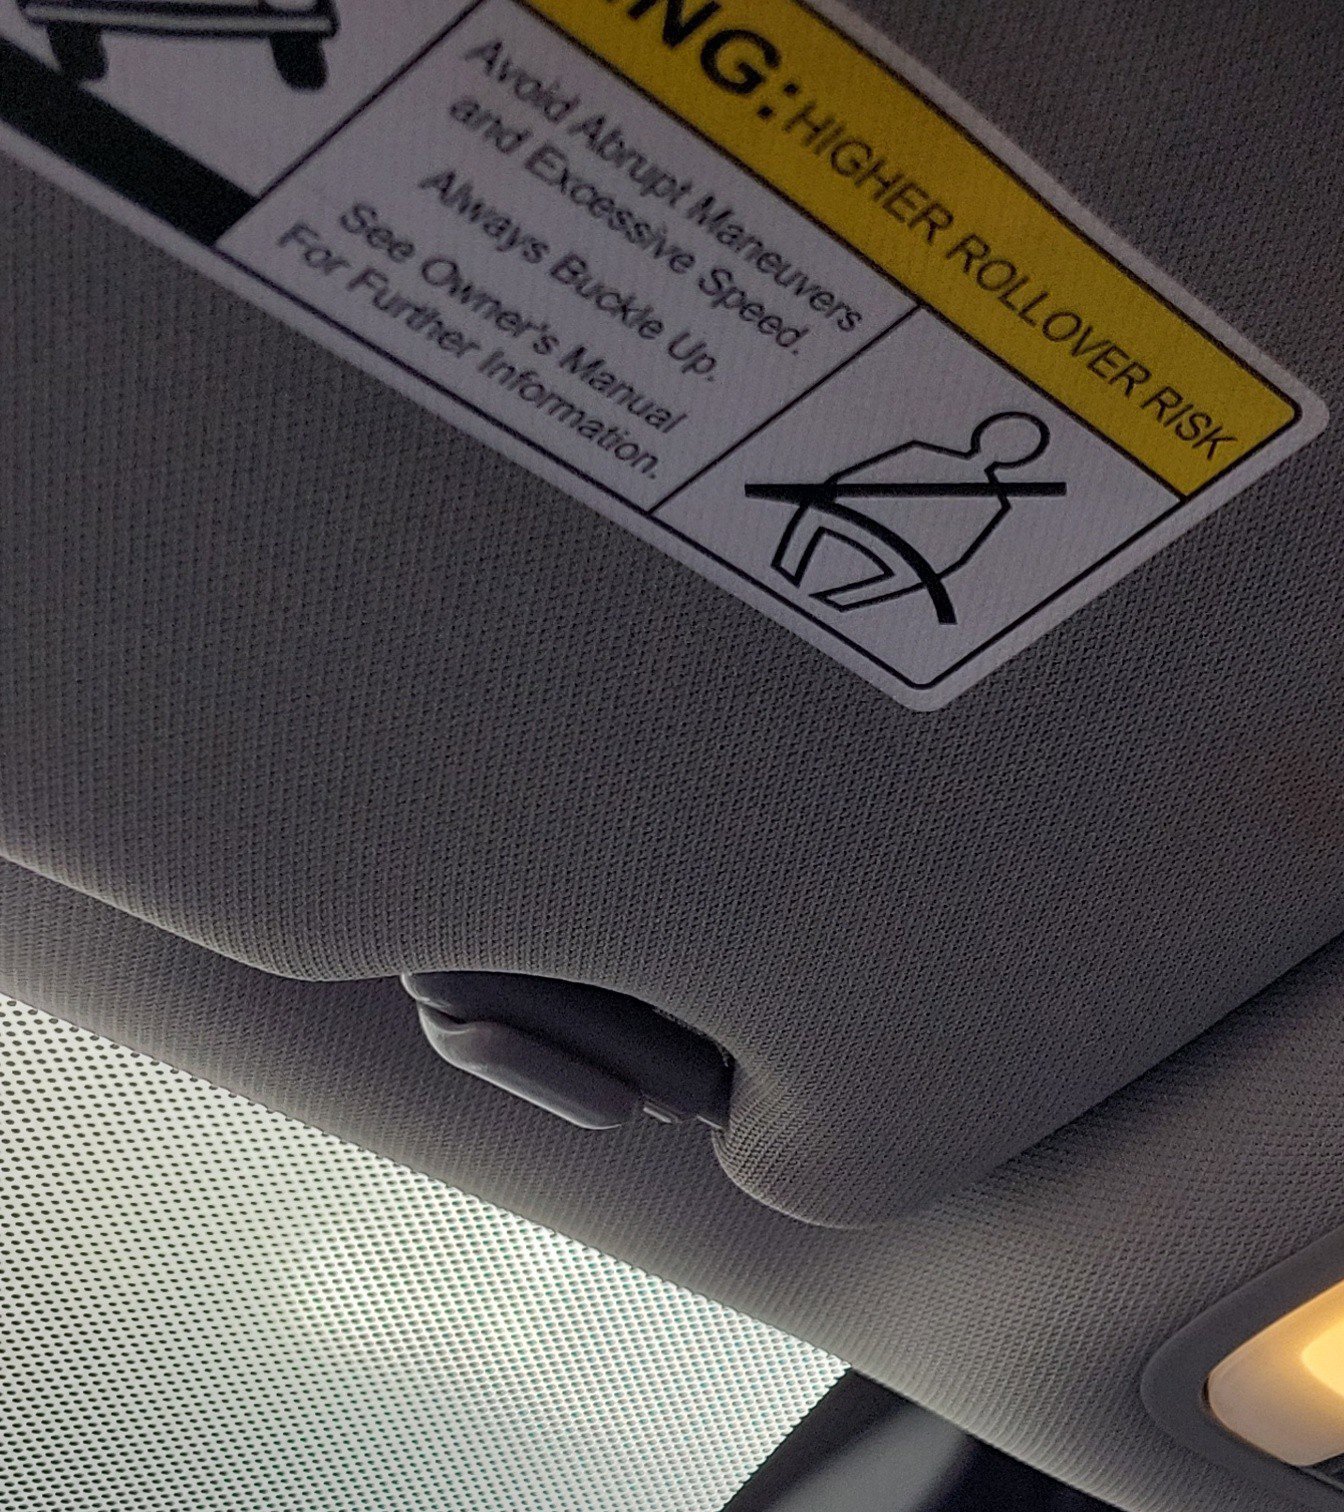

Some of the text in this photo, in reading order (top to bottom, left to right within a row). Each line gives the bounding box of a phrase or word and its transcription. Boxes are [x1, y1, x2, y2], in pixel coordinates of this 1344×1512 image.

[416, 169, 717, 382] Always Buckle Up.
[449, 97, 535, 154] and
[524, 142, 697, 276] Excessive
[463, 40, 863, 332] Avoid Abrupt Maneuvers
[784, 101, 954, 246] HIGHER
[944, 233, 1153, 398] ROLLOVER
[1140, 385, 1239, 461] RISK
[275, 217, 659, 481] For Further Information.
[338, 201, 688, 435] See Owner's Manual
